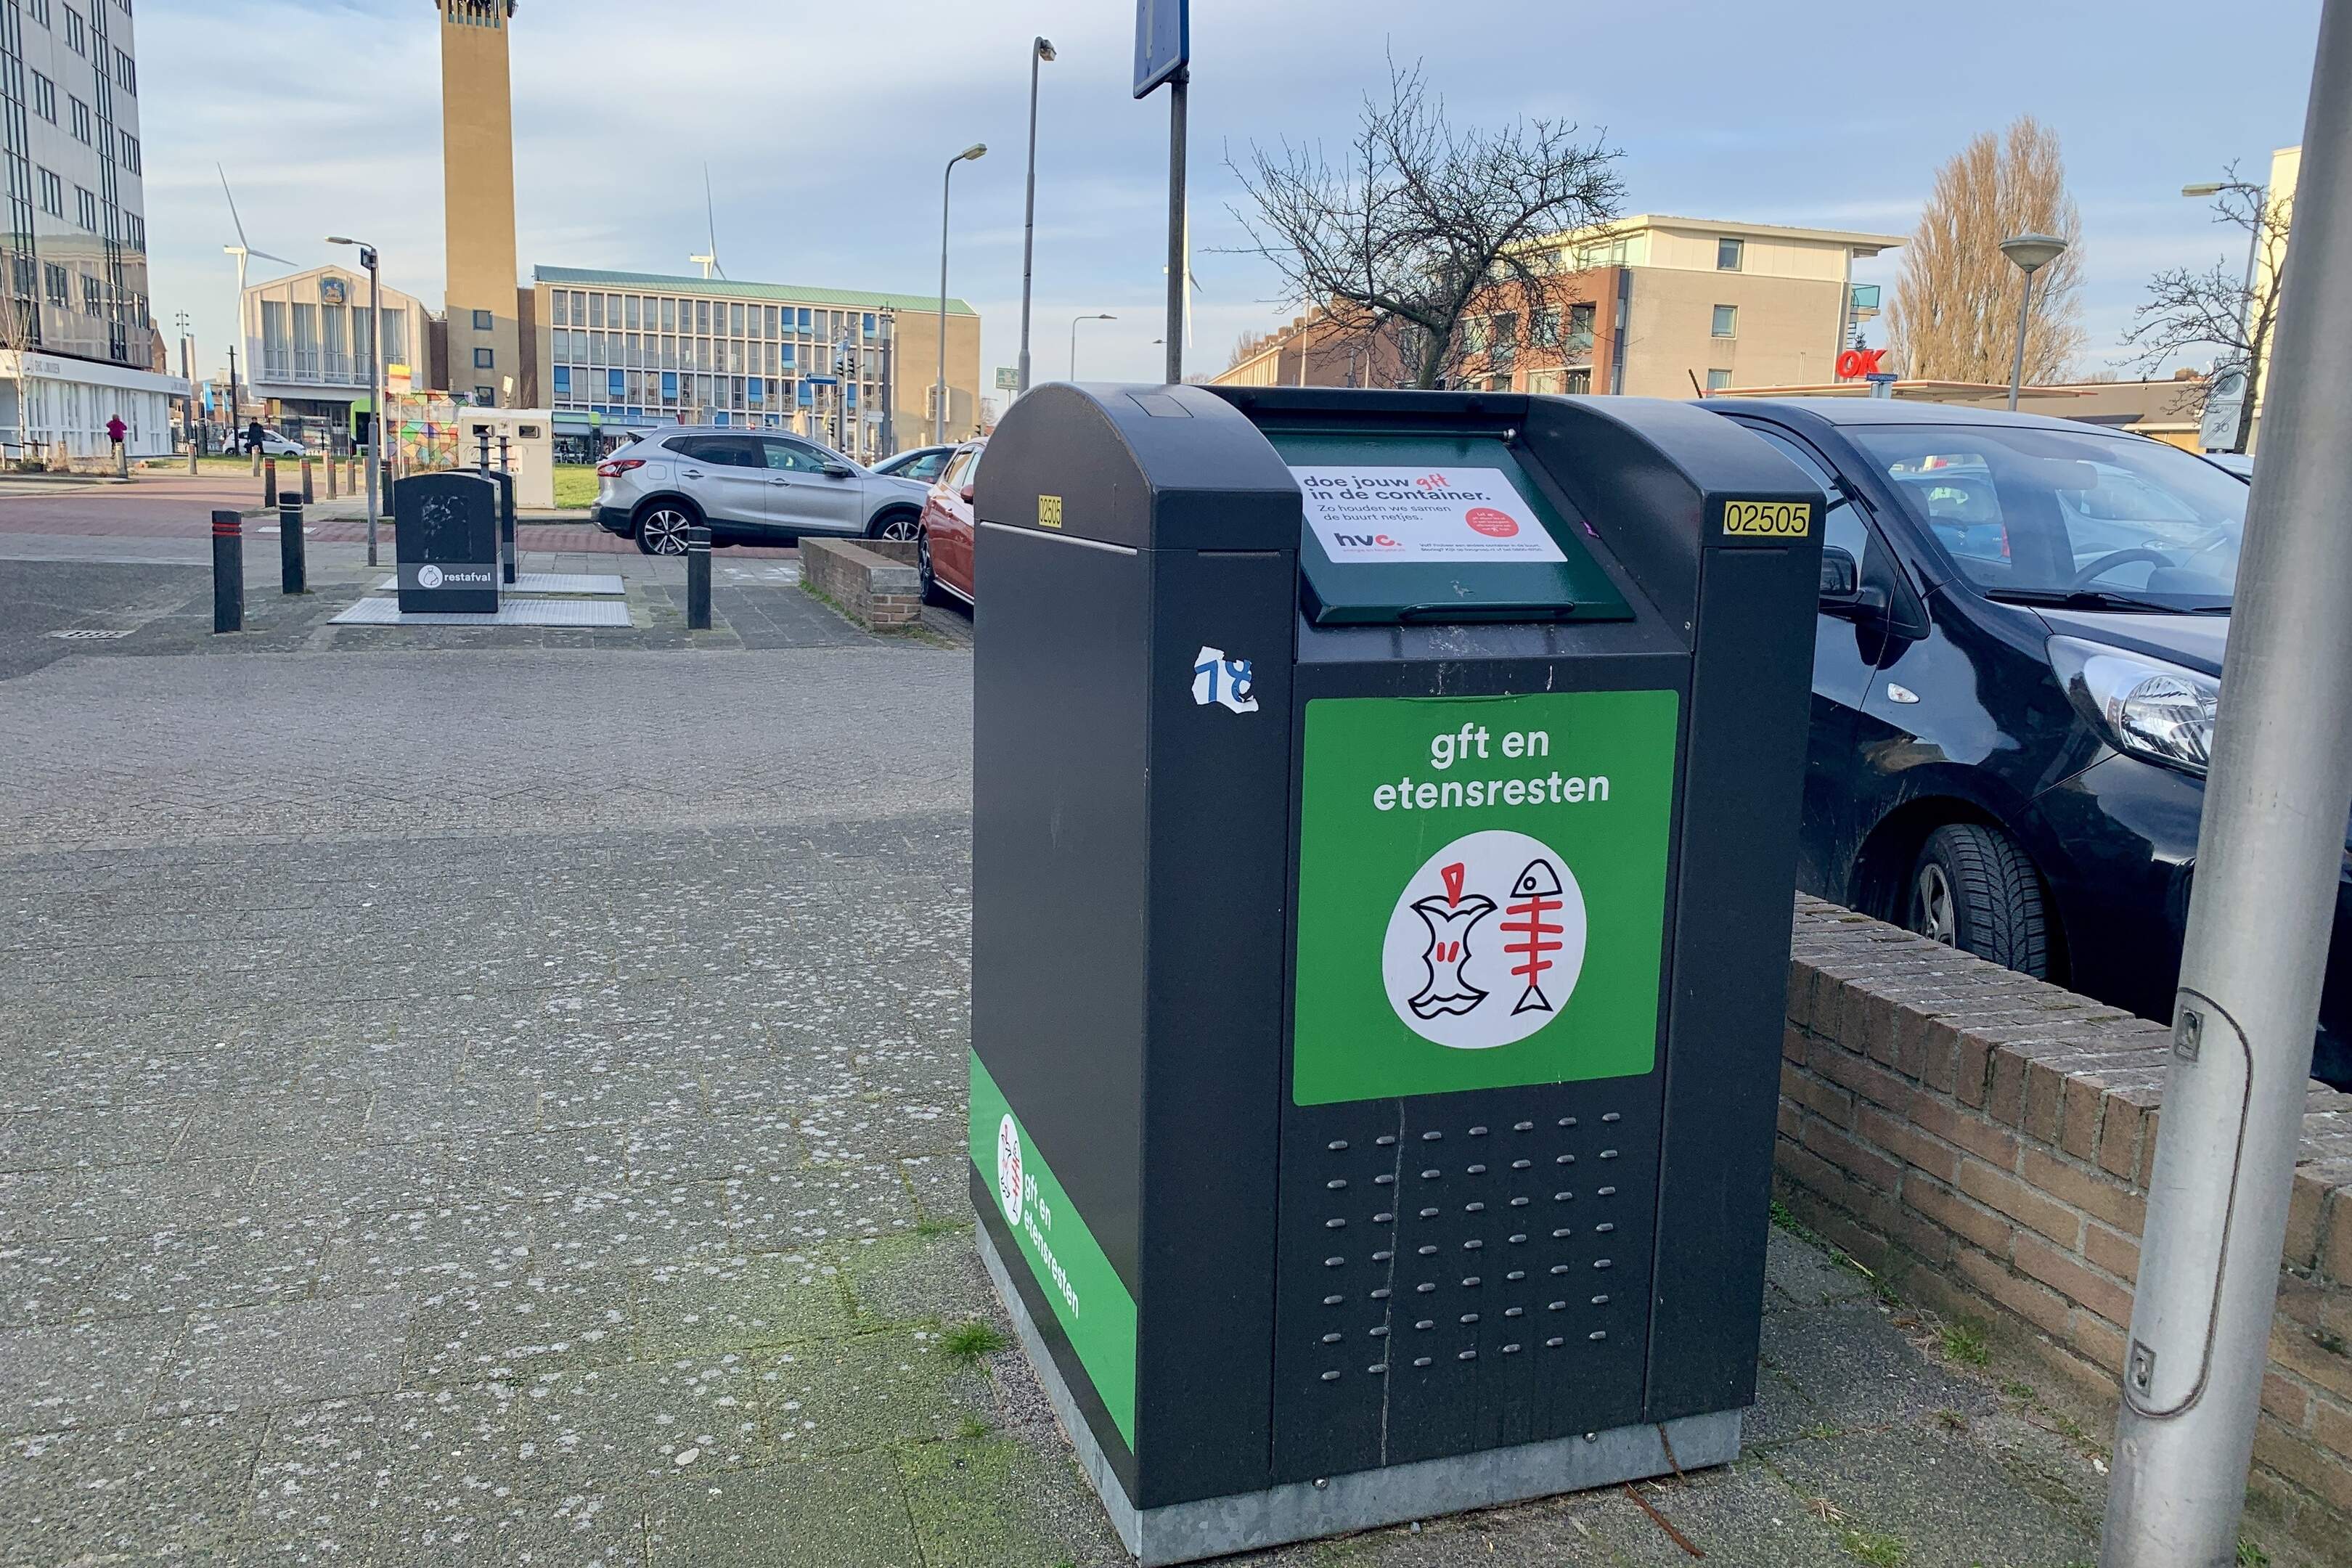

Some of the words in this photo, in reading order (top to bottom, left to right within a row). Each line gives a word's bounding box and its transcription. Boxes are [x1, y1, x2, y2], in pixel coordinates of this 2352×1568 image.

[1837, 349, 1887, 378] OK
[1304, 476, 1347, 487] doe
[1352, 476, 1409, 489] jouw
[1416, 473, 1450, 491] gft
[1309, 489, 1334, 499] in
[1340, 489, 1369, 499] de
[1376, 489, 1491, 500] container.
[1040, 498, 1061, 525] 02505
[1727, 505, 1806, 534] 02505
[444, 572, 491, 581] restafval
[1430, 722, 1490, 770] gft
[1501, 729, 1550, 758] en
[1373, 771, 1609, 811] etensresten
[1024, 1173, 1038, 1209] gft
[1040, 1198, 1051, 1231] en
[1024, 1209, 1079, 1319] etensresten
